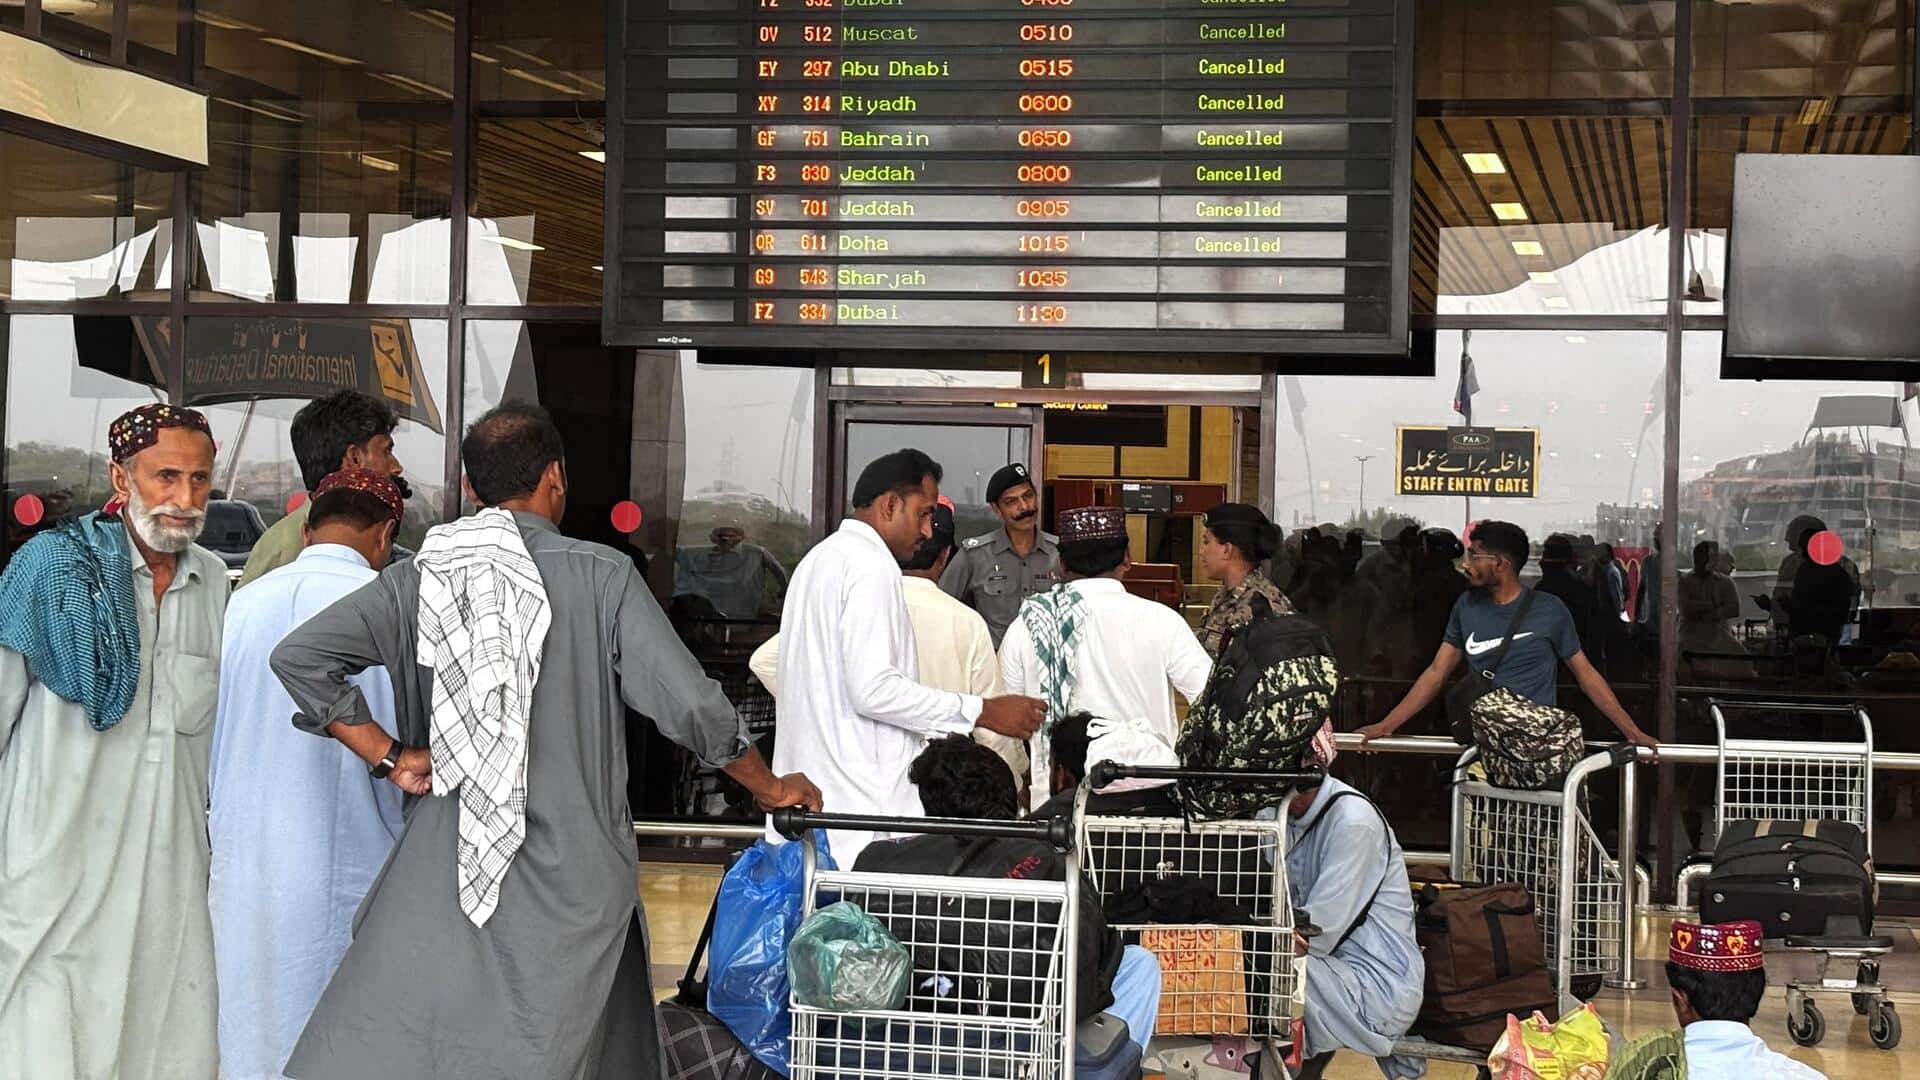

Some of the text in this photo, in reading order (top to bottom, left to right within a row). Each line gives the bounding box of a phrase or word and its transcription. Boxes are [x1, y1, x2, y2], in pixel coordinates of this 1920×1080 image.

[804, 26, 832, 42] 512
[843, 26, 918, 41] Muscat
[1020, 24, 1073, 40] 0510
[1199, 24, 1285, 40] Cancelled
[758, 59, 1285, 77] EY 297 Abu Dhabi 0515 Cancelled
[757, 94, 1284, 115] XY 314 Riyadh 0600 Cancelled
[757, 130, 1283, 146] GF 751 Bahrain 0650 Cancelled
[757, 165, 1282, 182] F3 830 Jeddah 0800 Cancelled
[756, 199, 1281, 217] SV 701 Jeddah 0905 Cancelled
[800, 234, 827, 250] 611
[839, 235, 889, 250] Doha
[1017, 235, 1069, 251] 1015
[1195, 237, 1281, 253] Cancelled
[755, 268, 1068, 289] G9 543 Sharjah 1035
[754, 303, 774, 320] FZ
[799, 303, 827, 320] 334
[838, 304, 898, 320] Dubai
[1037, 353, 1050, 385] 1
[1463, 435, 1480, 443] PAA
[1403, 476, 1529, 493] STAFF ENTRY GATE
[1175, 495, 1183, 503] 10
